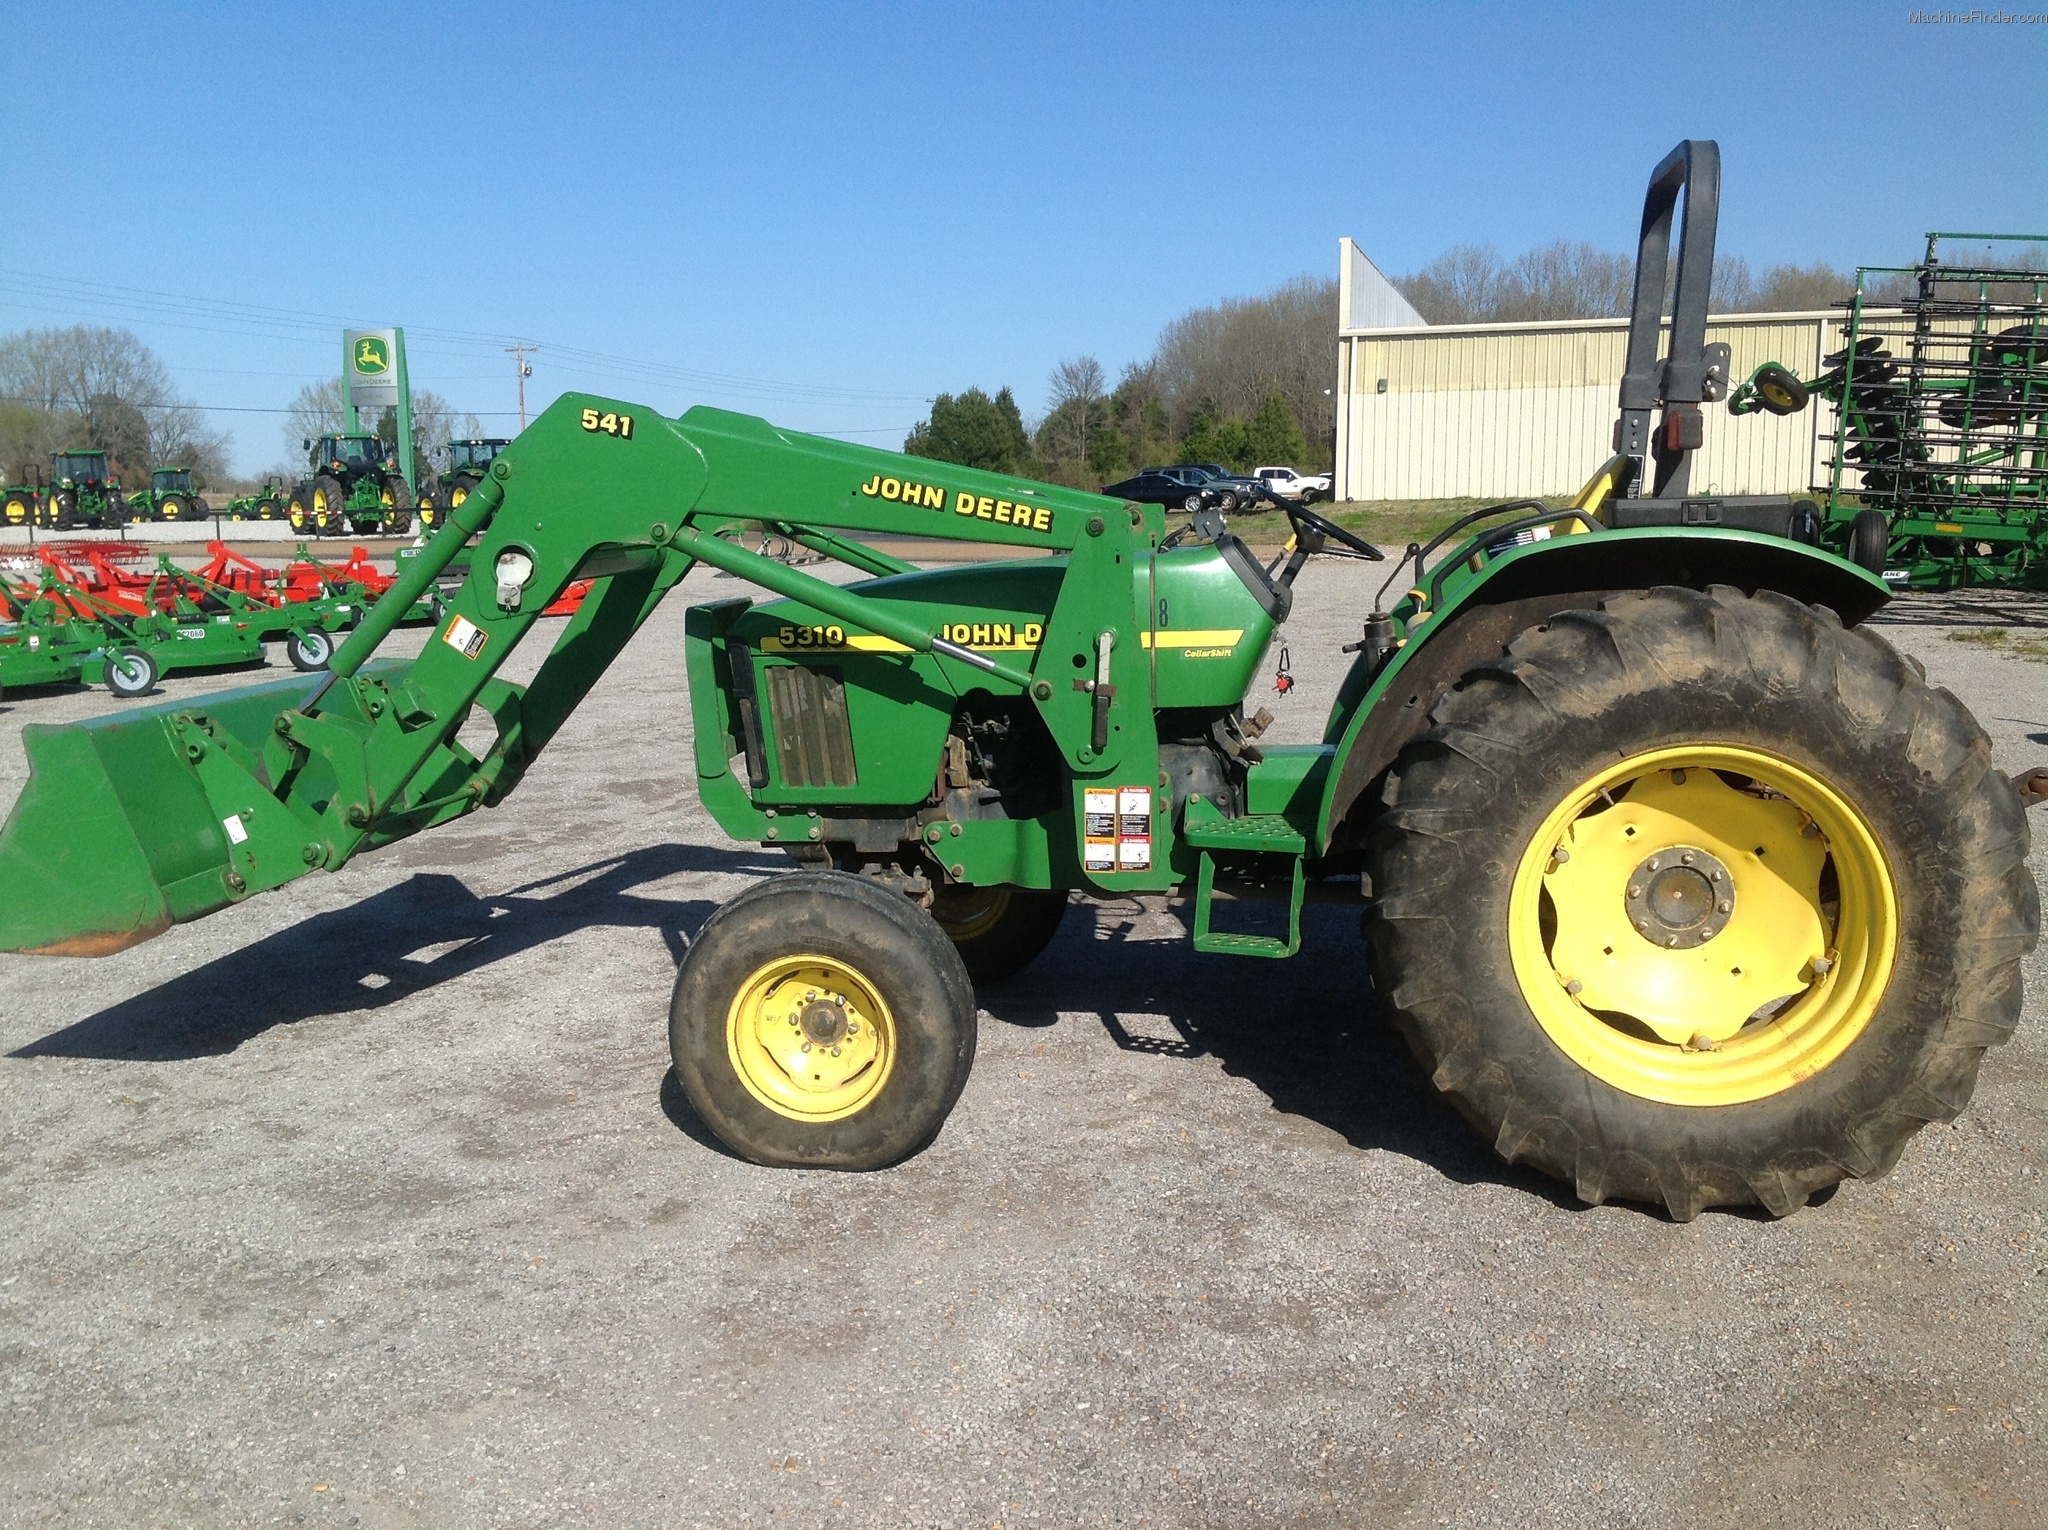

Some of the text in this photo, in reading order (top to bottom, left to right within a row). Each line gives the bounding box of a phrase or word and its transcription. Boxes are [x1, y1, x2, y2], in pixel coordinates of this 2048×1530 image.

[581, 408, 634, 440] 541
[862, 475, 1053, 533] JOHN DEERE
[779, 625, 845, 647] 5310
[1184, 649, 1232, 658] CollarShift
